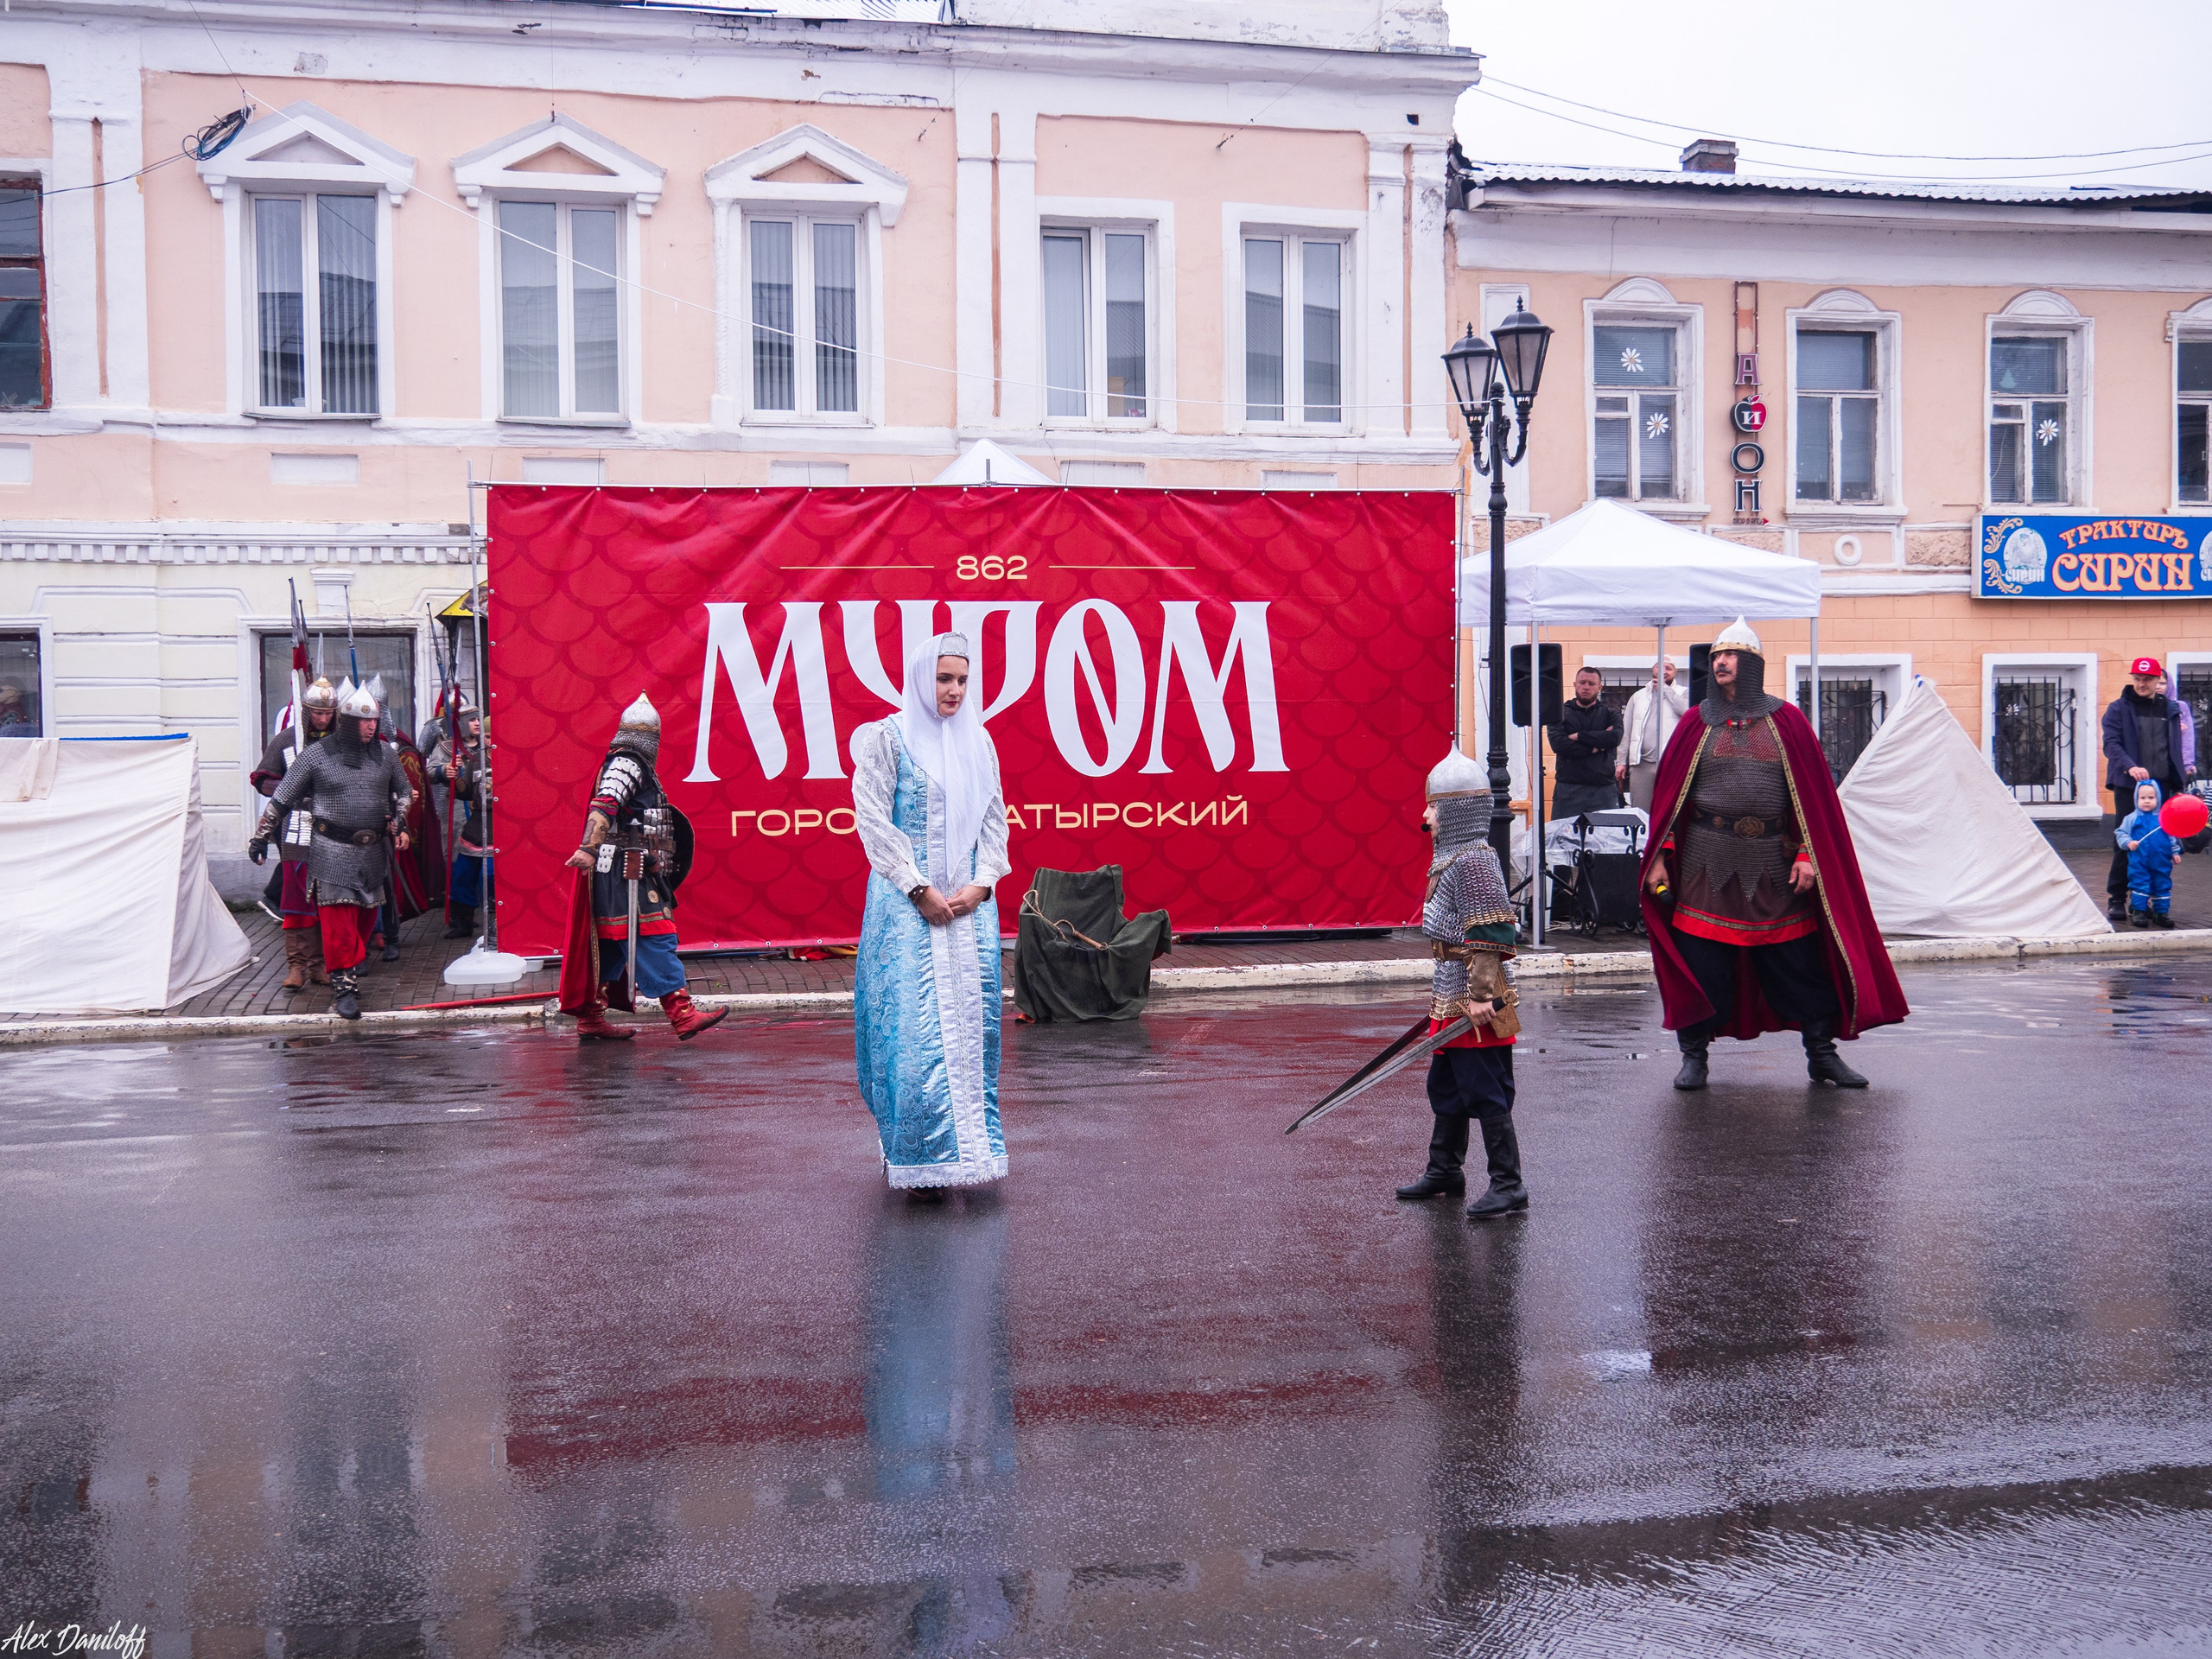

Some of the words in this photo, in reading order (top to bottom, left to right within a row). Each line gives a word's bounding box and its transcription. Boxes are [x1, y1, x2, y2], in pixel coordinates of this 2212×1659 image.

[956, 555, 1028, 581] 862
[2052, 553, 2195, 591] СИРИН
[731, 807, 857, 837] ГОРО
[1005, 794, 1248, 830] АТЫРСКИЙ
